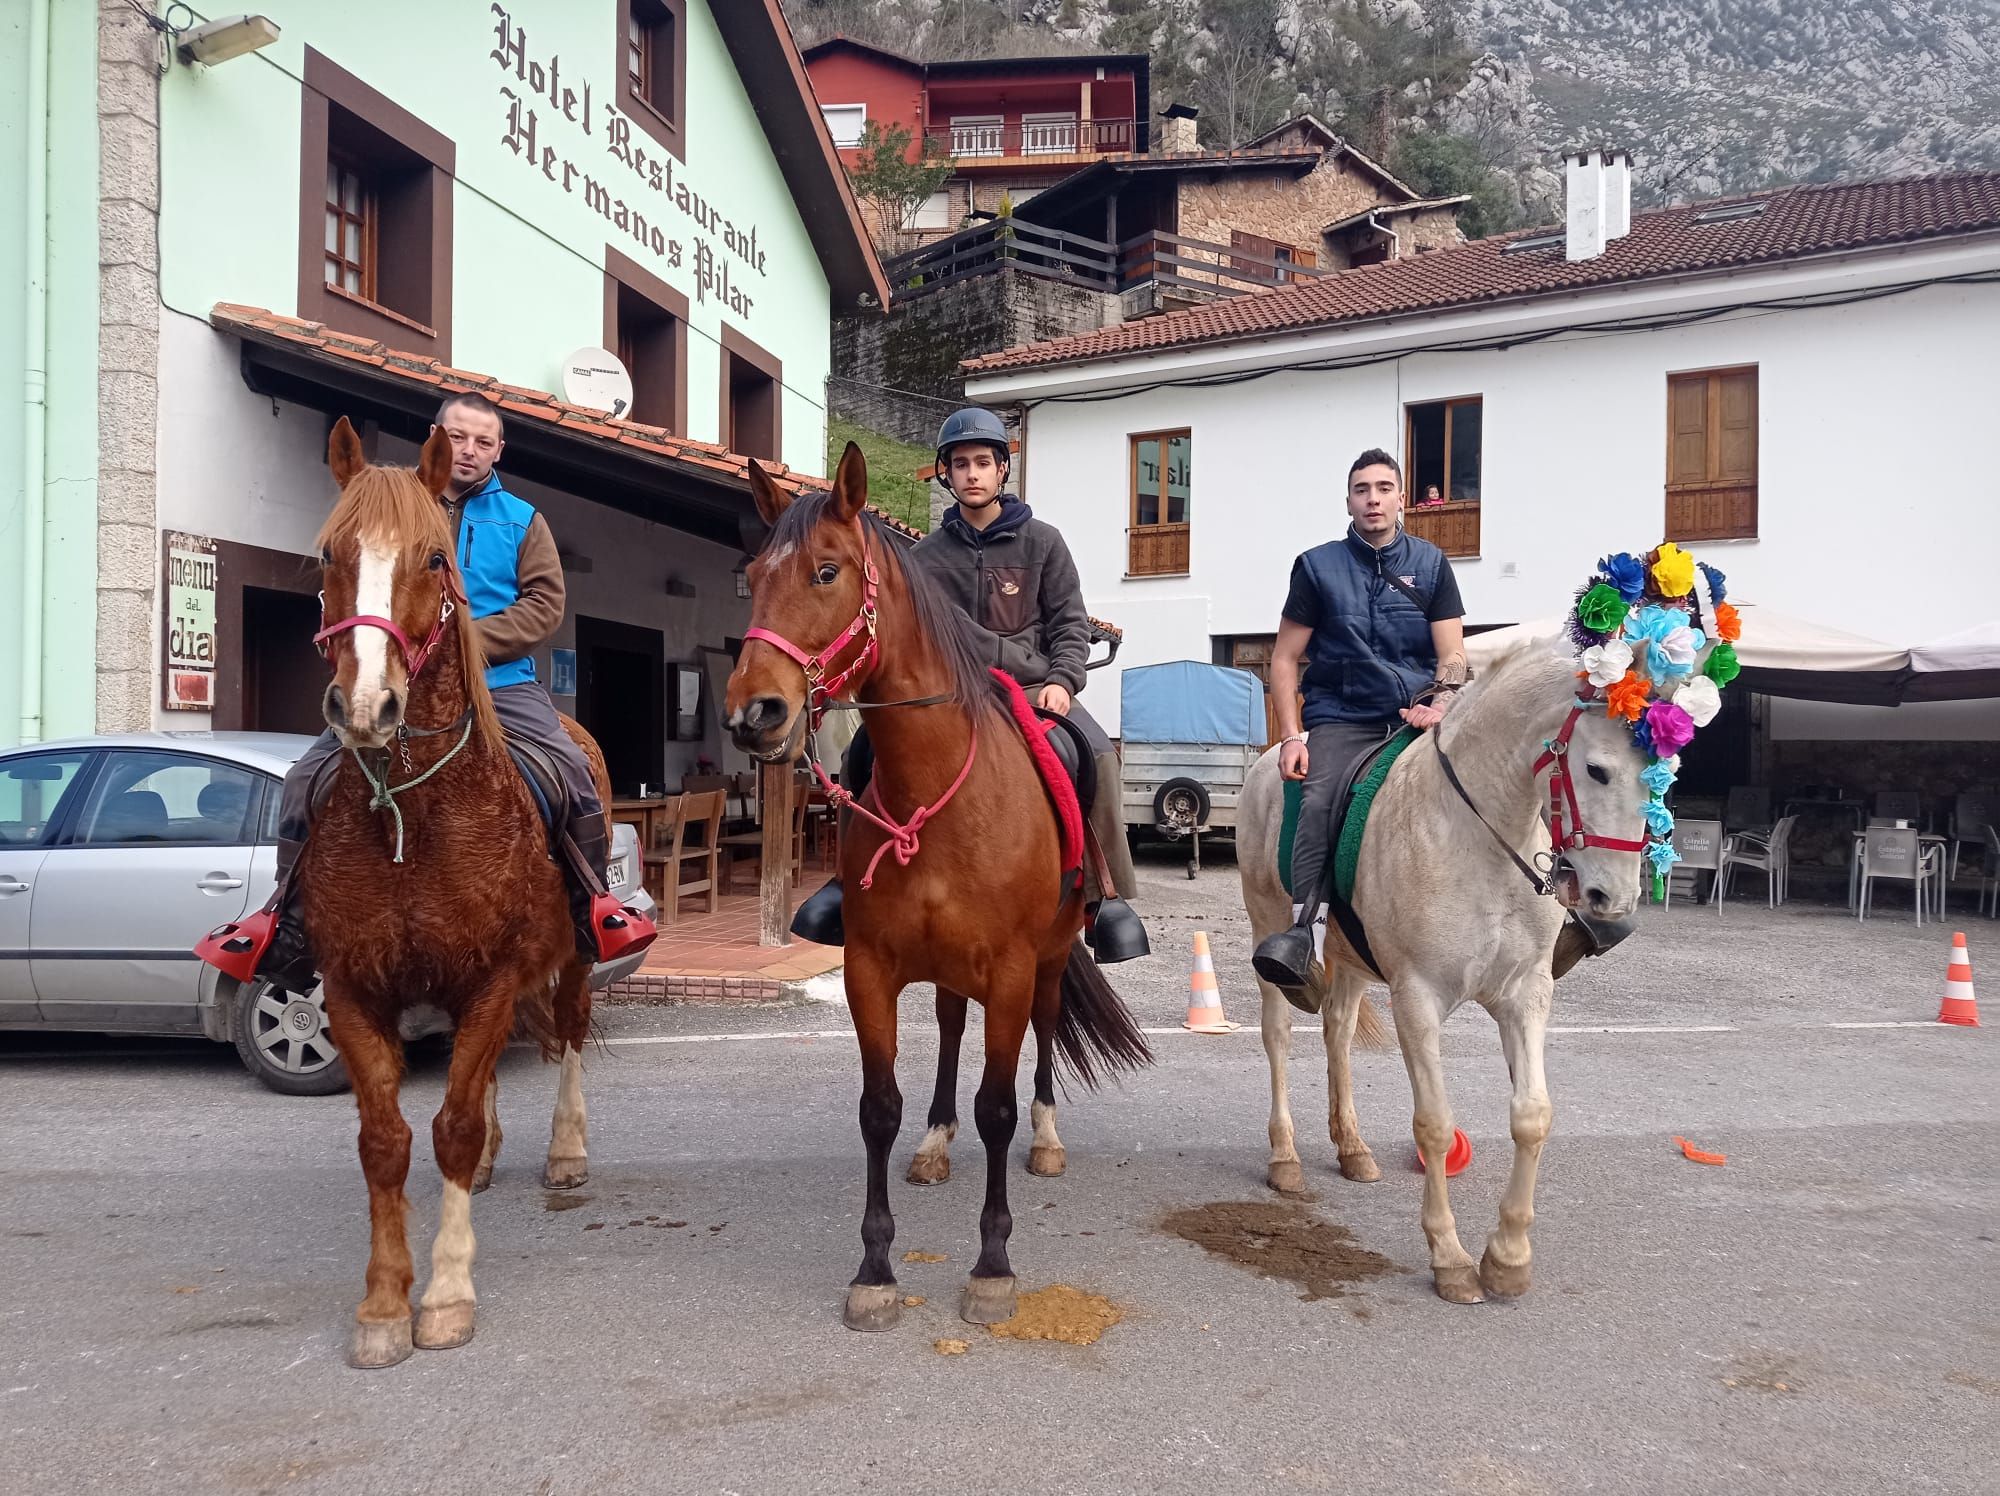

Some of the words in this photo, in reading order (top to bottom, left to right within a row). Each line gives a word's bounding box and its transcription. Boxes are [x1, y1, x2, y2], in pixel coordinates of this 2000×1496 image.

[490, 2, 592, 136] Hotel
[605, 103, 767, 277] Restaurante
[499, 86, 683, 269] Hermanos
[692, 236, 754, 320] Pilar
[169, 555, 215, 592] menu
[169, 616, 214, 662] dia
[557, 663, 571, 689] H
[1145, 784, 1152, 792] 5
